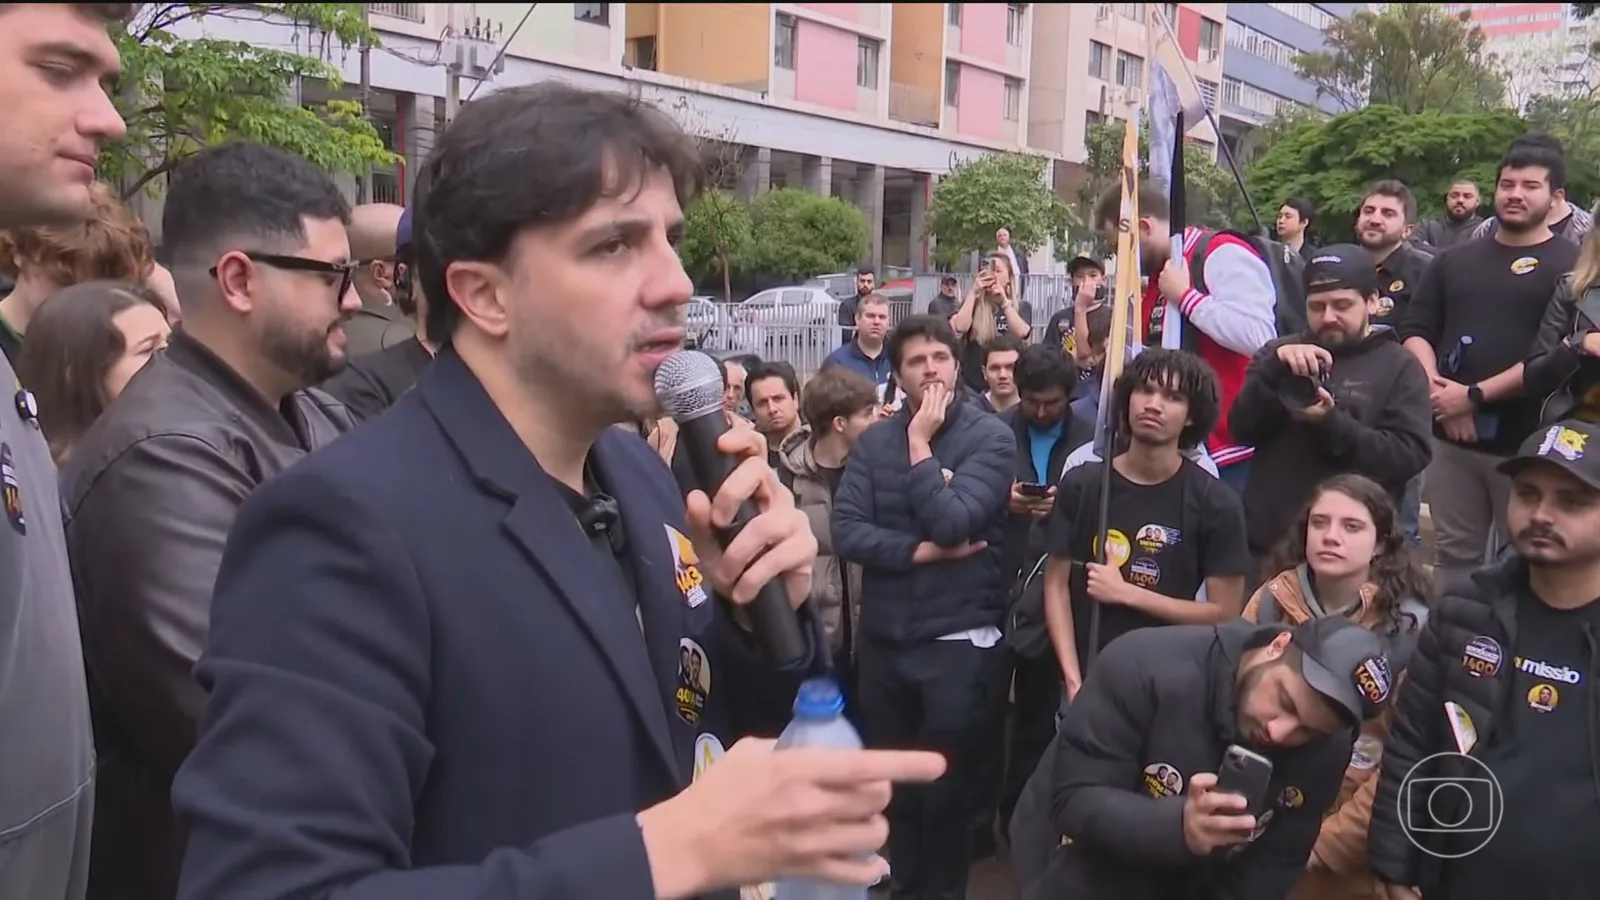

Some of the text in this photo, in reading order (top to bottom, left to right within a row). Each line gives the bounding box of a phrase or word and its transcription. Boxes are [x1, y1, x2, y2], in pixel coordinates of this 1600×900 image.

[1463, 655, 1495, 675] 1400
[1521, 658, 1580, 685] missão
[1355, 665, 1380, 700] 1400
